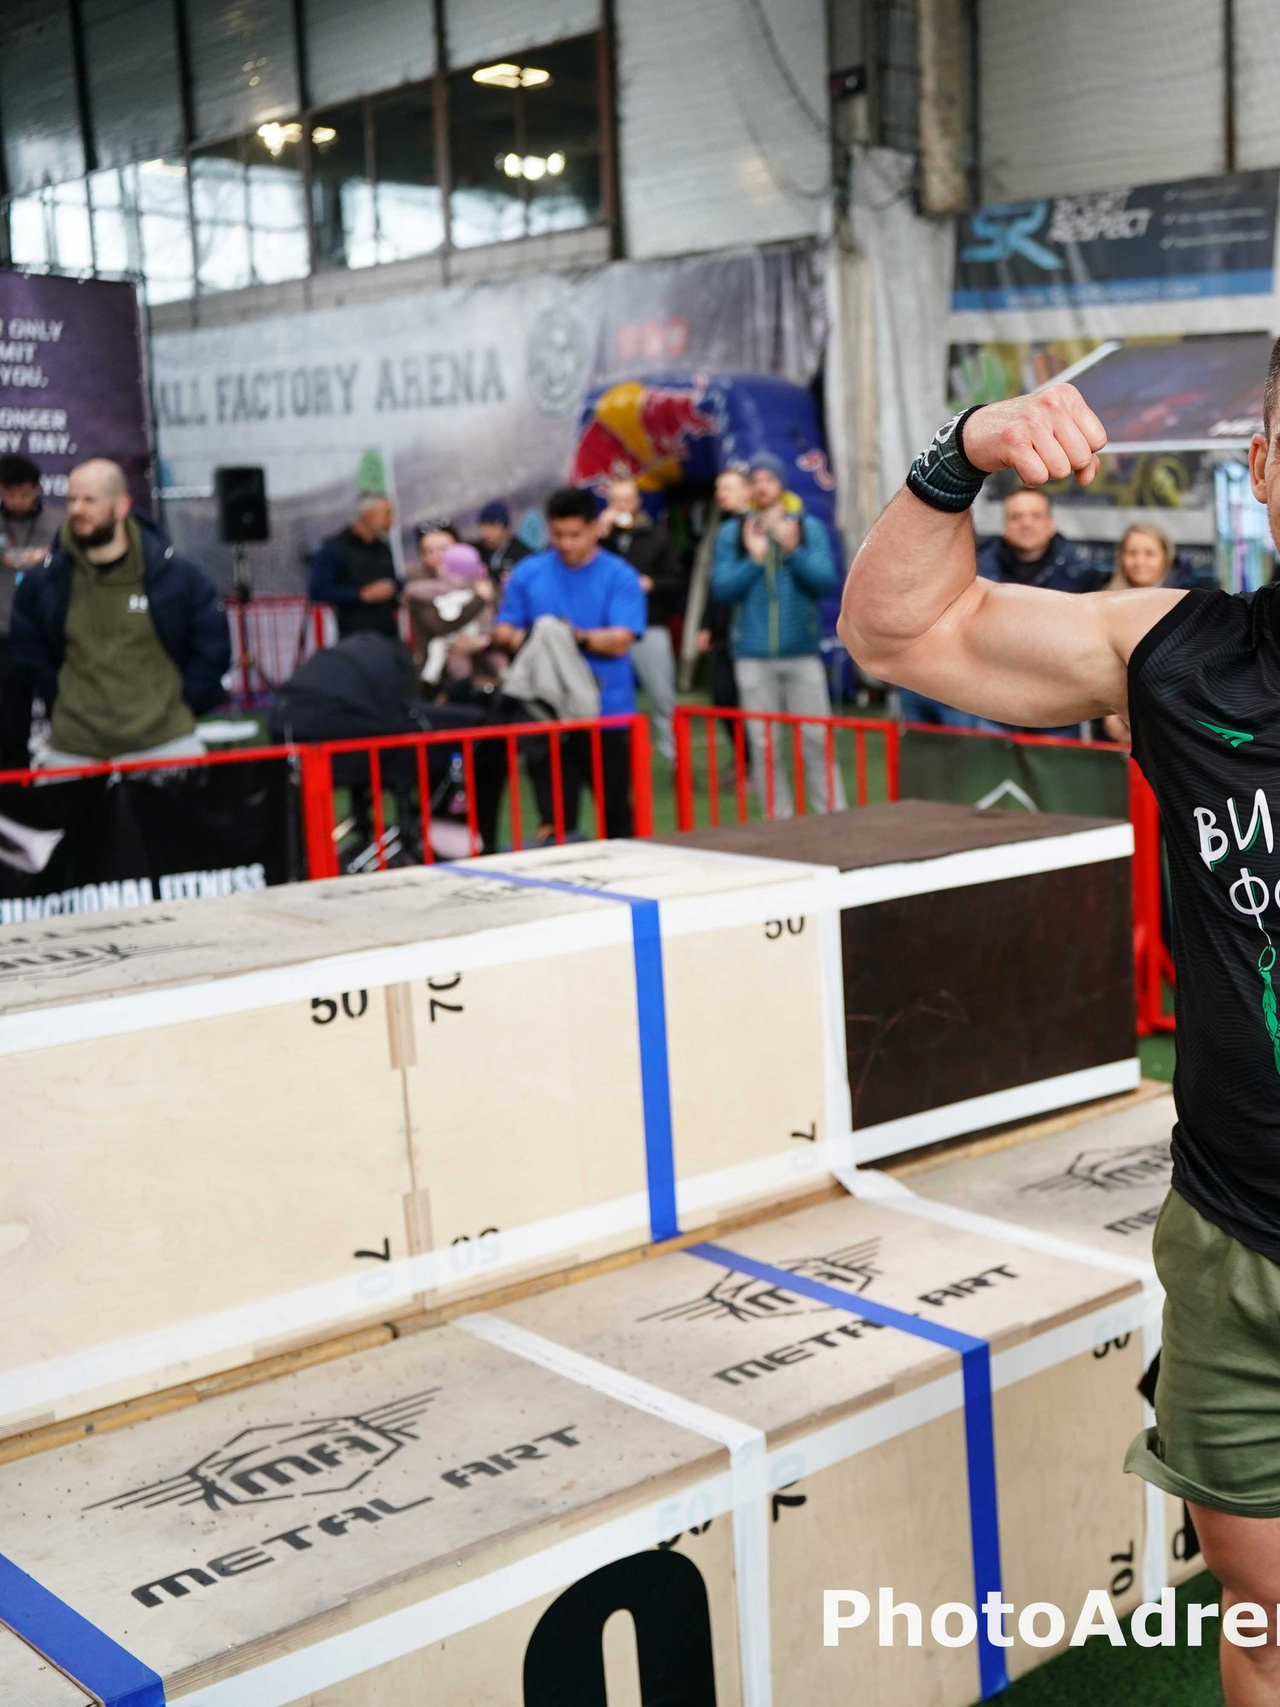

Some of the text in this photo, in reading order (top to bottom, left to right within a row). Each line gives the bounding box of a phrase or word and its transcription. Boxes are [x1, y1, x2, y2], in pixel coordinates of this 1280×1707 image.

[215, 362, 362, 425] FACTORY
[375, 344, 506, 412] ARENA
[0, 877, 153, 925] UNCTIONAL
[917, 1263, 1021, 1308] ART
[130, 1424, 584, 1609] METAL ART
